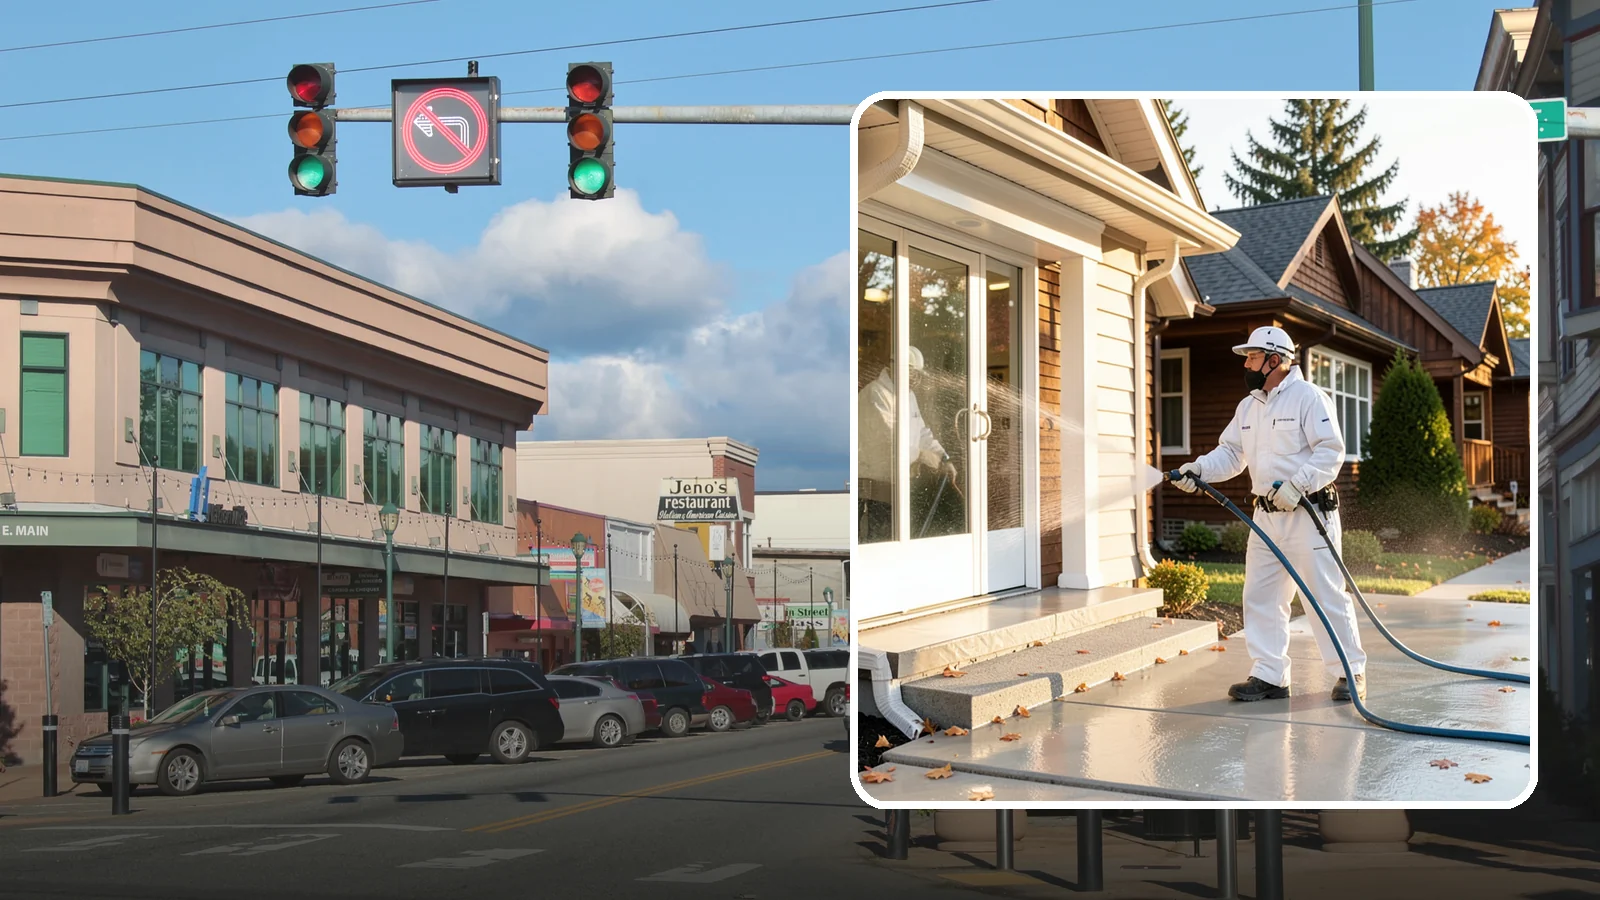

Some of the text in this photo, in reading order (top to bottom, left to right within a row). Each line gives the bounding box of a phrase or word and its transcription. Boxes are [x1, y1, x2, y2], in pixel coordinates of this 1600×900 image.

[670, 480, 727, 494] Jeno's
[665, 496, 730, 508] restaurant
[659, 510, 680, 519] Italian
[686, 510, 714, 519] American
[715, 510, 737, 519] Cuisine
[2, 525, 49, 536] E. MAIN
[798, 608, 828, 616] Street
